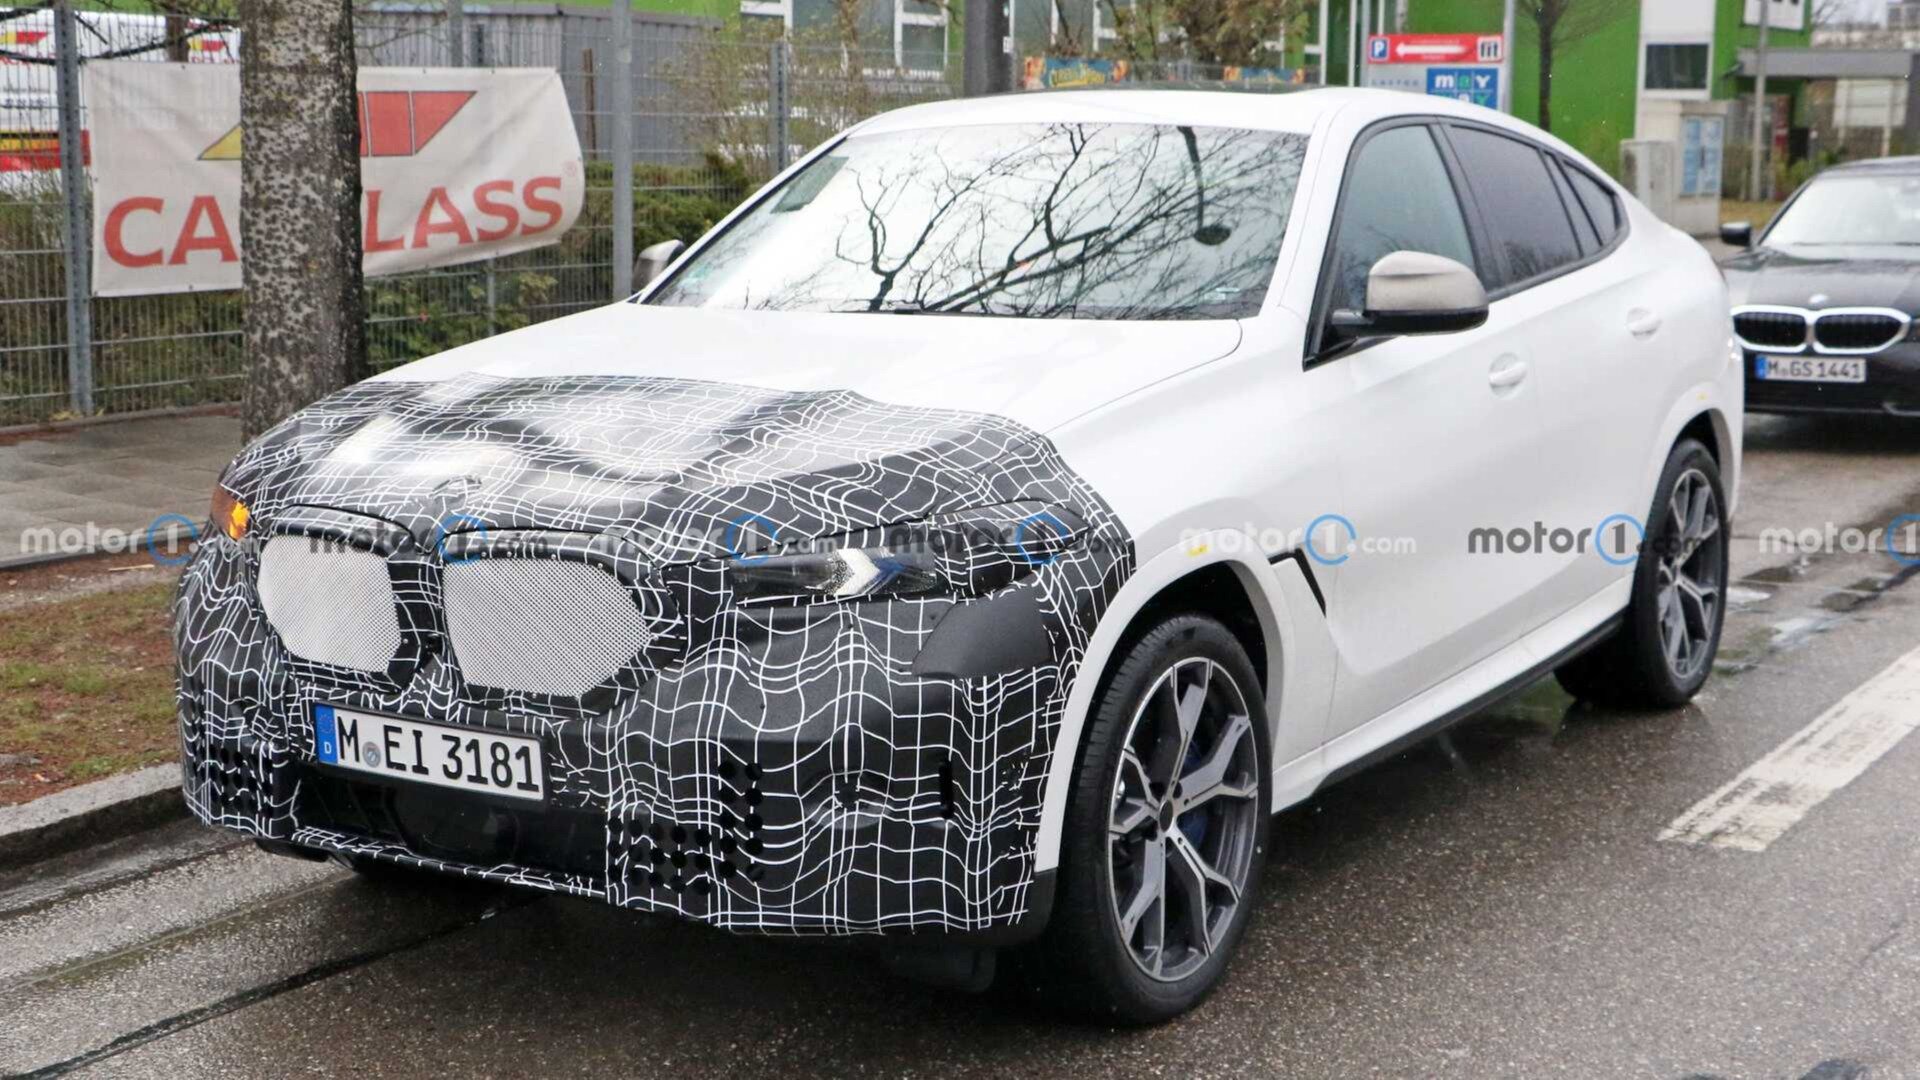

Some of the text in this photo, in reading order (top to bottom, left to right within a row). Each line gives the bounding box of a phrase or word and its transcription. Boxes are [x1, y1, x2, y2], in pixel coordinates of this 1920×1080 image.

[1373, 39, 1385, 58] P
[103, 176, 563, 268] CALASS
[1767, 360, 1860, 379] M GS 1441
[337, 715, 540, 793] M EI 3181
